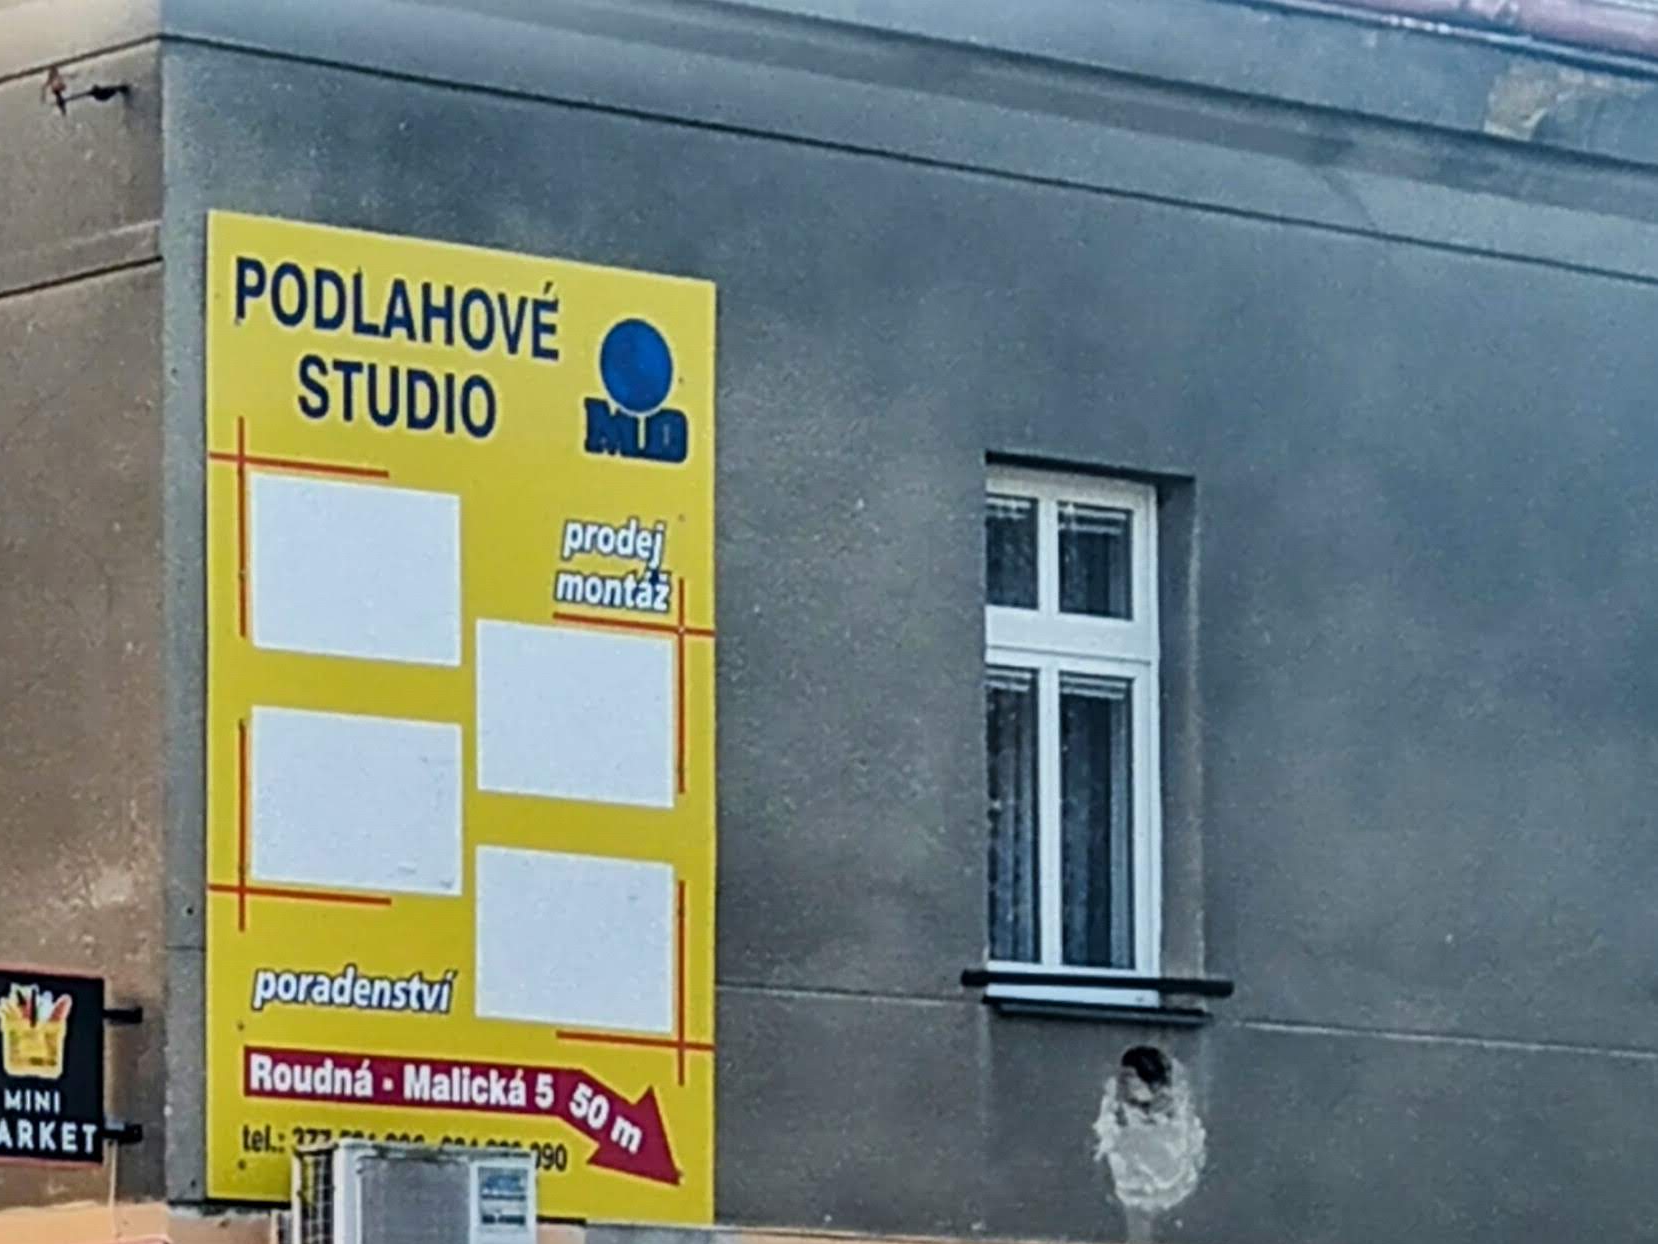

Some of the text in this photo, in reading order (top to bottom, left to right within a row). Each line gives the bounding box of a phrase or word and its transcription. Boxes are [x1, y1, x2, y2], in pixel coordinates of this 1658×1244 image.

[235, 256, 559, 360] PODLAHOVÉ
[298, 355, 497, 438] STUDIO
[561, 516, 666, 569] prodej
[556, 571, 670, 613] montáž
[252, 964, 458, 1013] poradenství
[4, 1088, 61, 1115] MINI
[249, 1053, 642, 1154] Roudná Malická 5 50 m
[242, 1124, 285, 1152] tel.:
